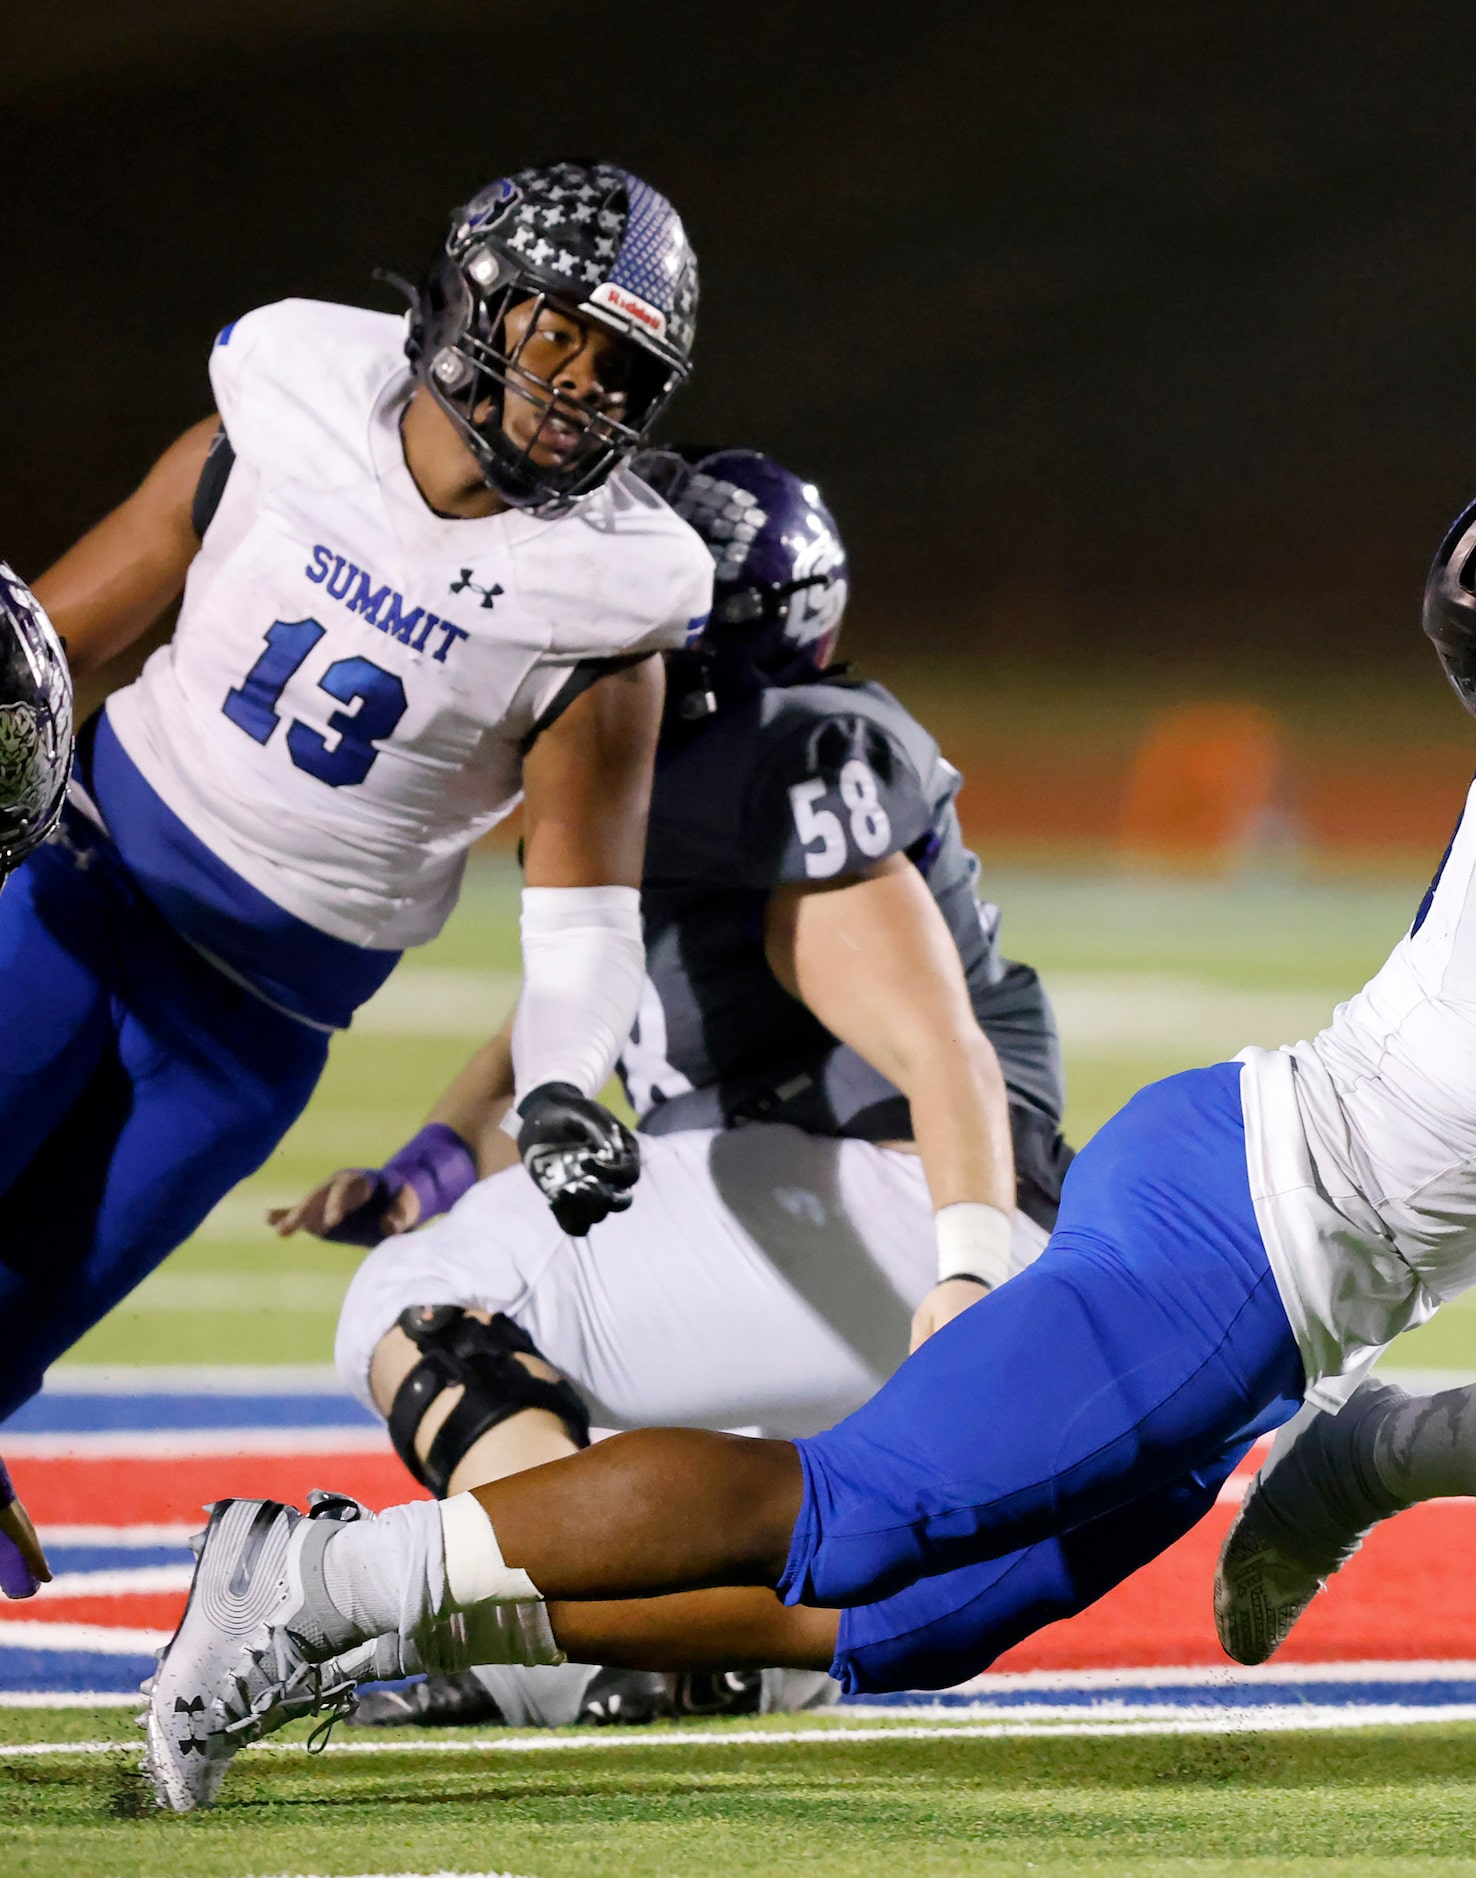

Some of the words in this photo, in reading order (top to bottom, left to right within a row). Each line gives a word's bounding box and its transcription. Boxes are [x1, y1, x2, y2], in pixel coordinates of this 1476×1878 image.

[305, 544, 471, 663] SUMMIT
[221, 617, 408, 788] 13
[790, 758, 892, 879] 58
